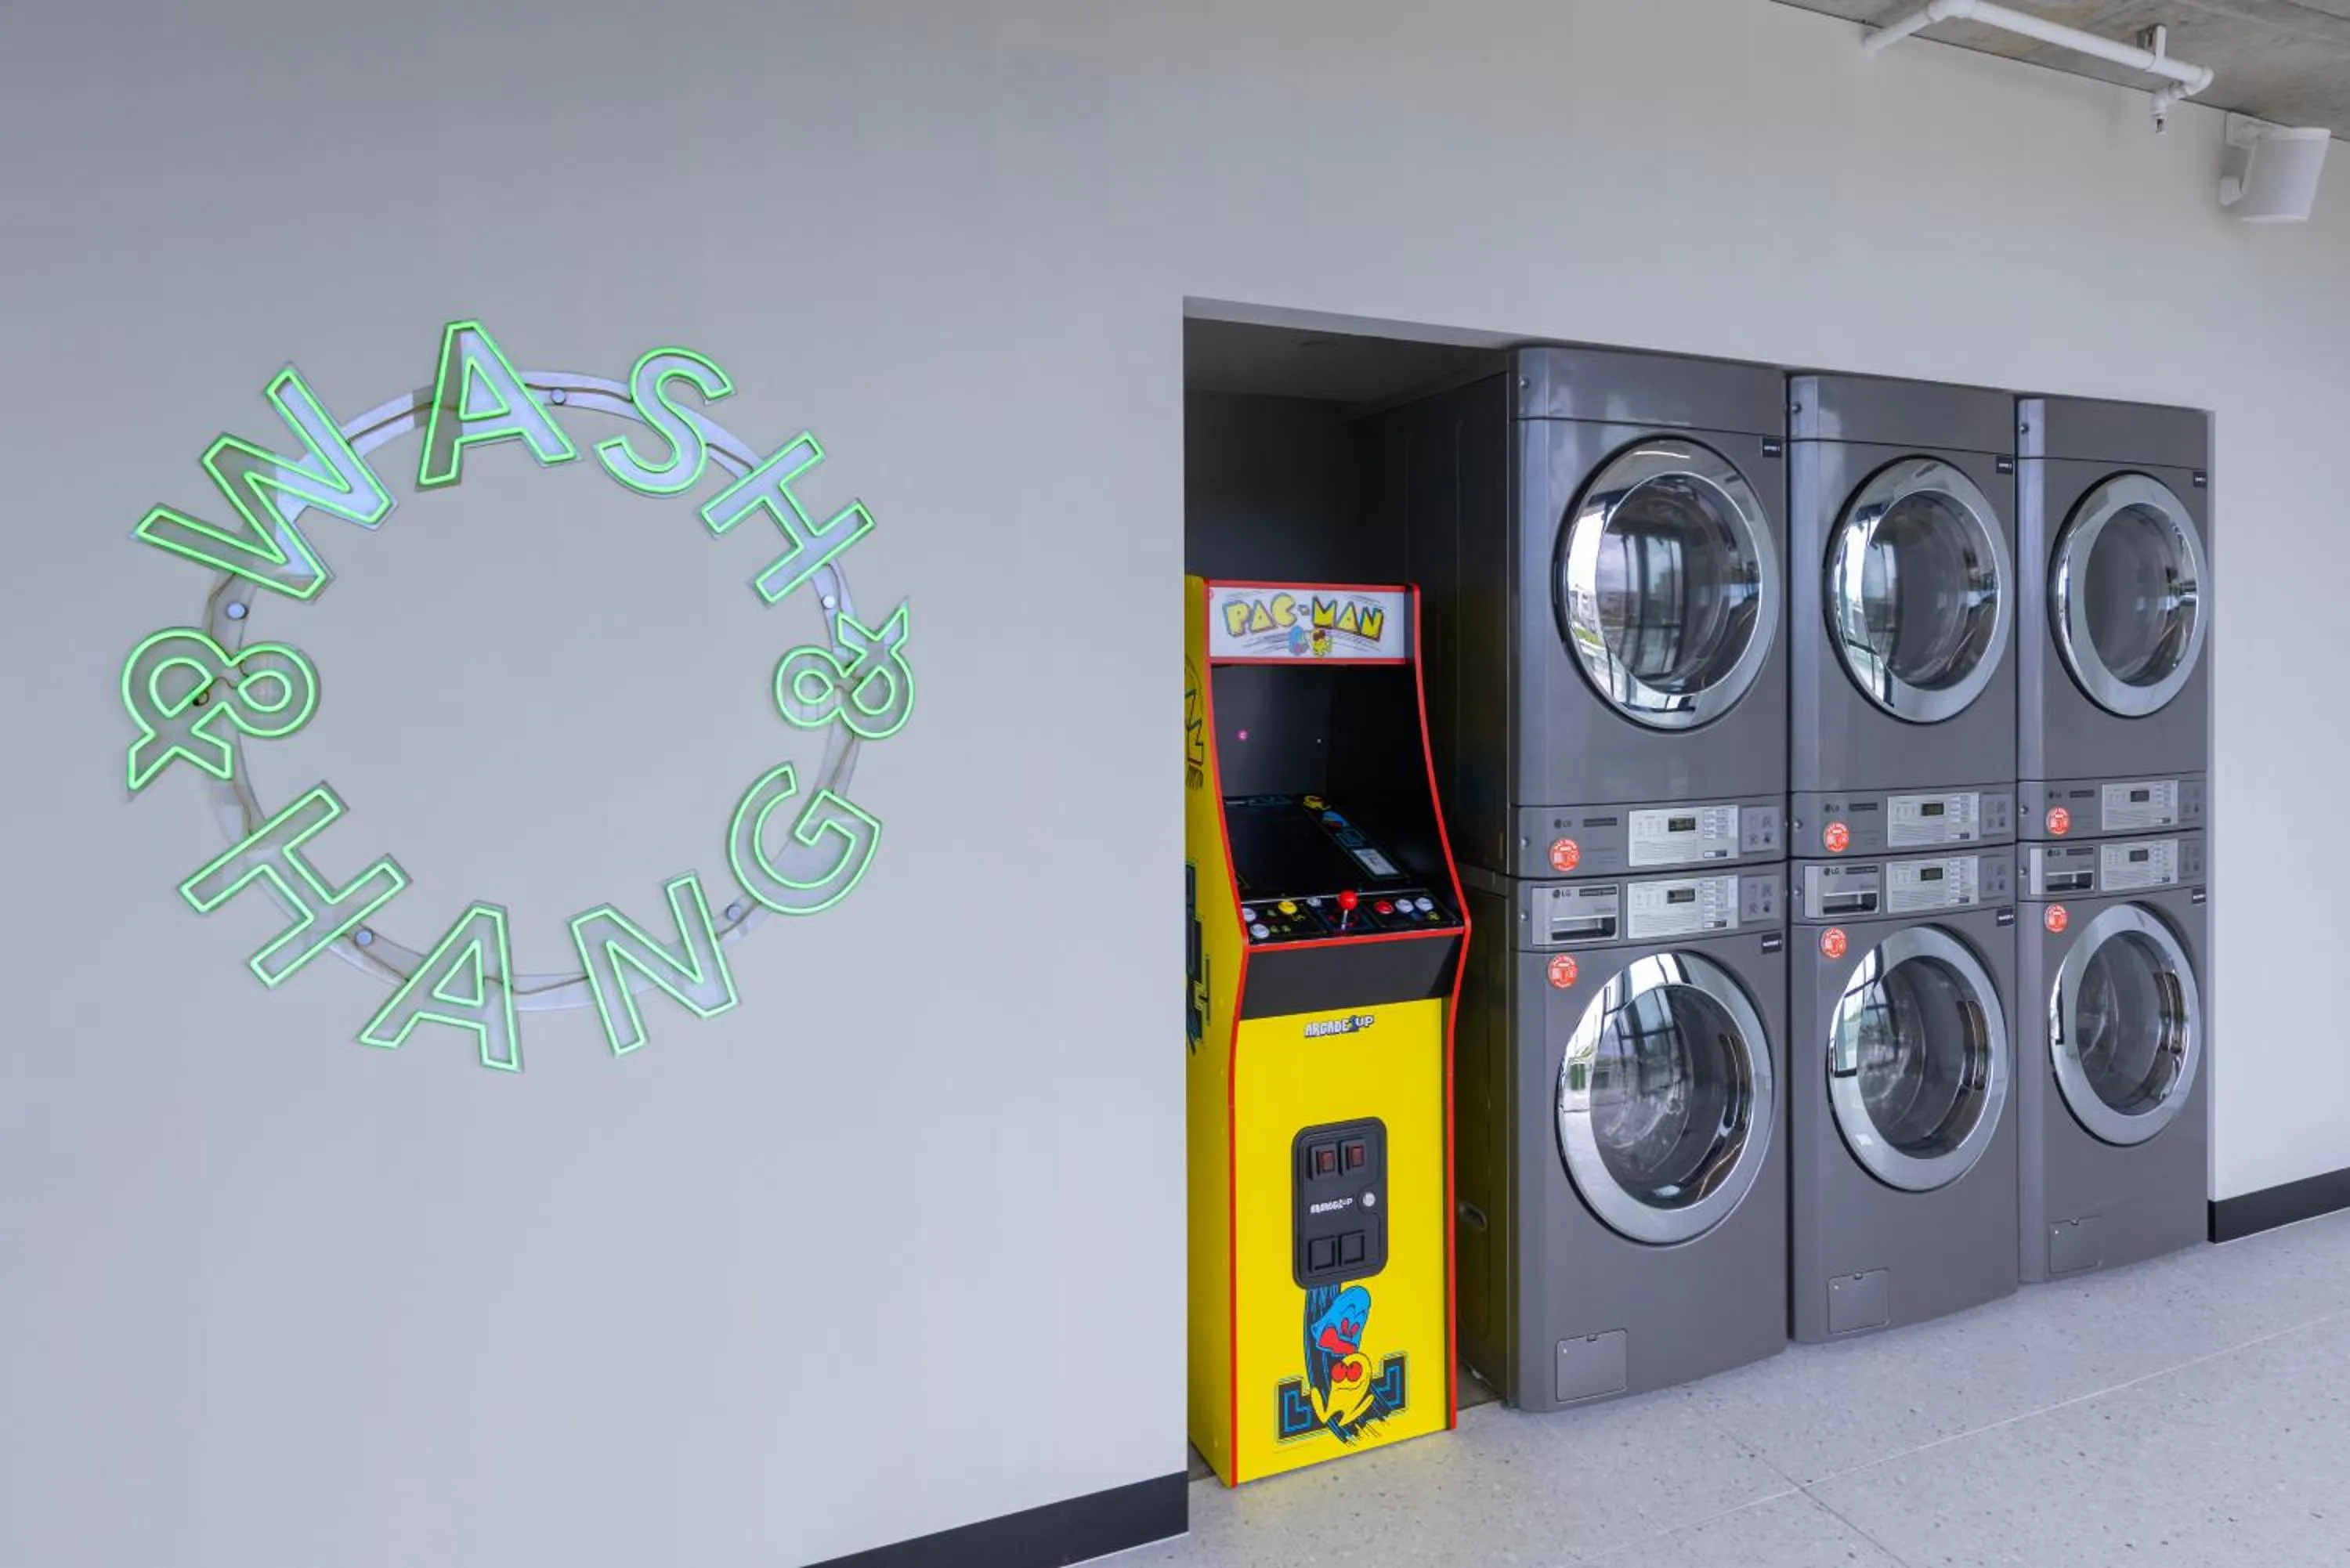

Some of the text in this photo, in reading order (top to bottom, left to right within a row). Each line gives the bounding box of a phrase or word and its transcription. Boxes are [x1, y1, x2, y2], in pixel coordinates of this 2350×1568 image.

[121, 318, 916, 1071] WASH & HANG &
